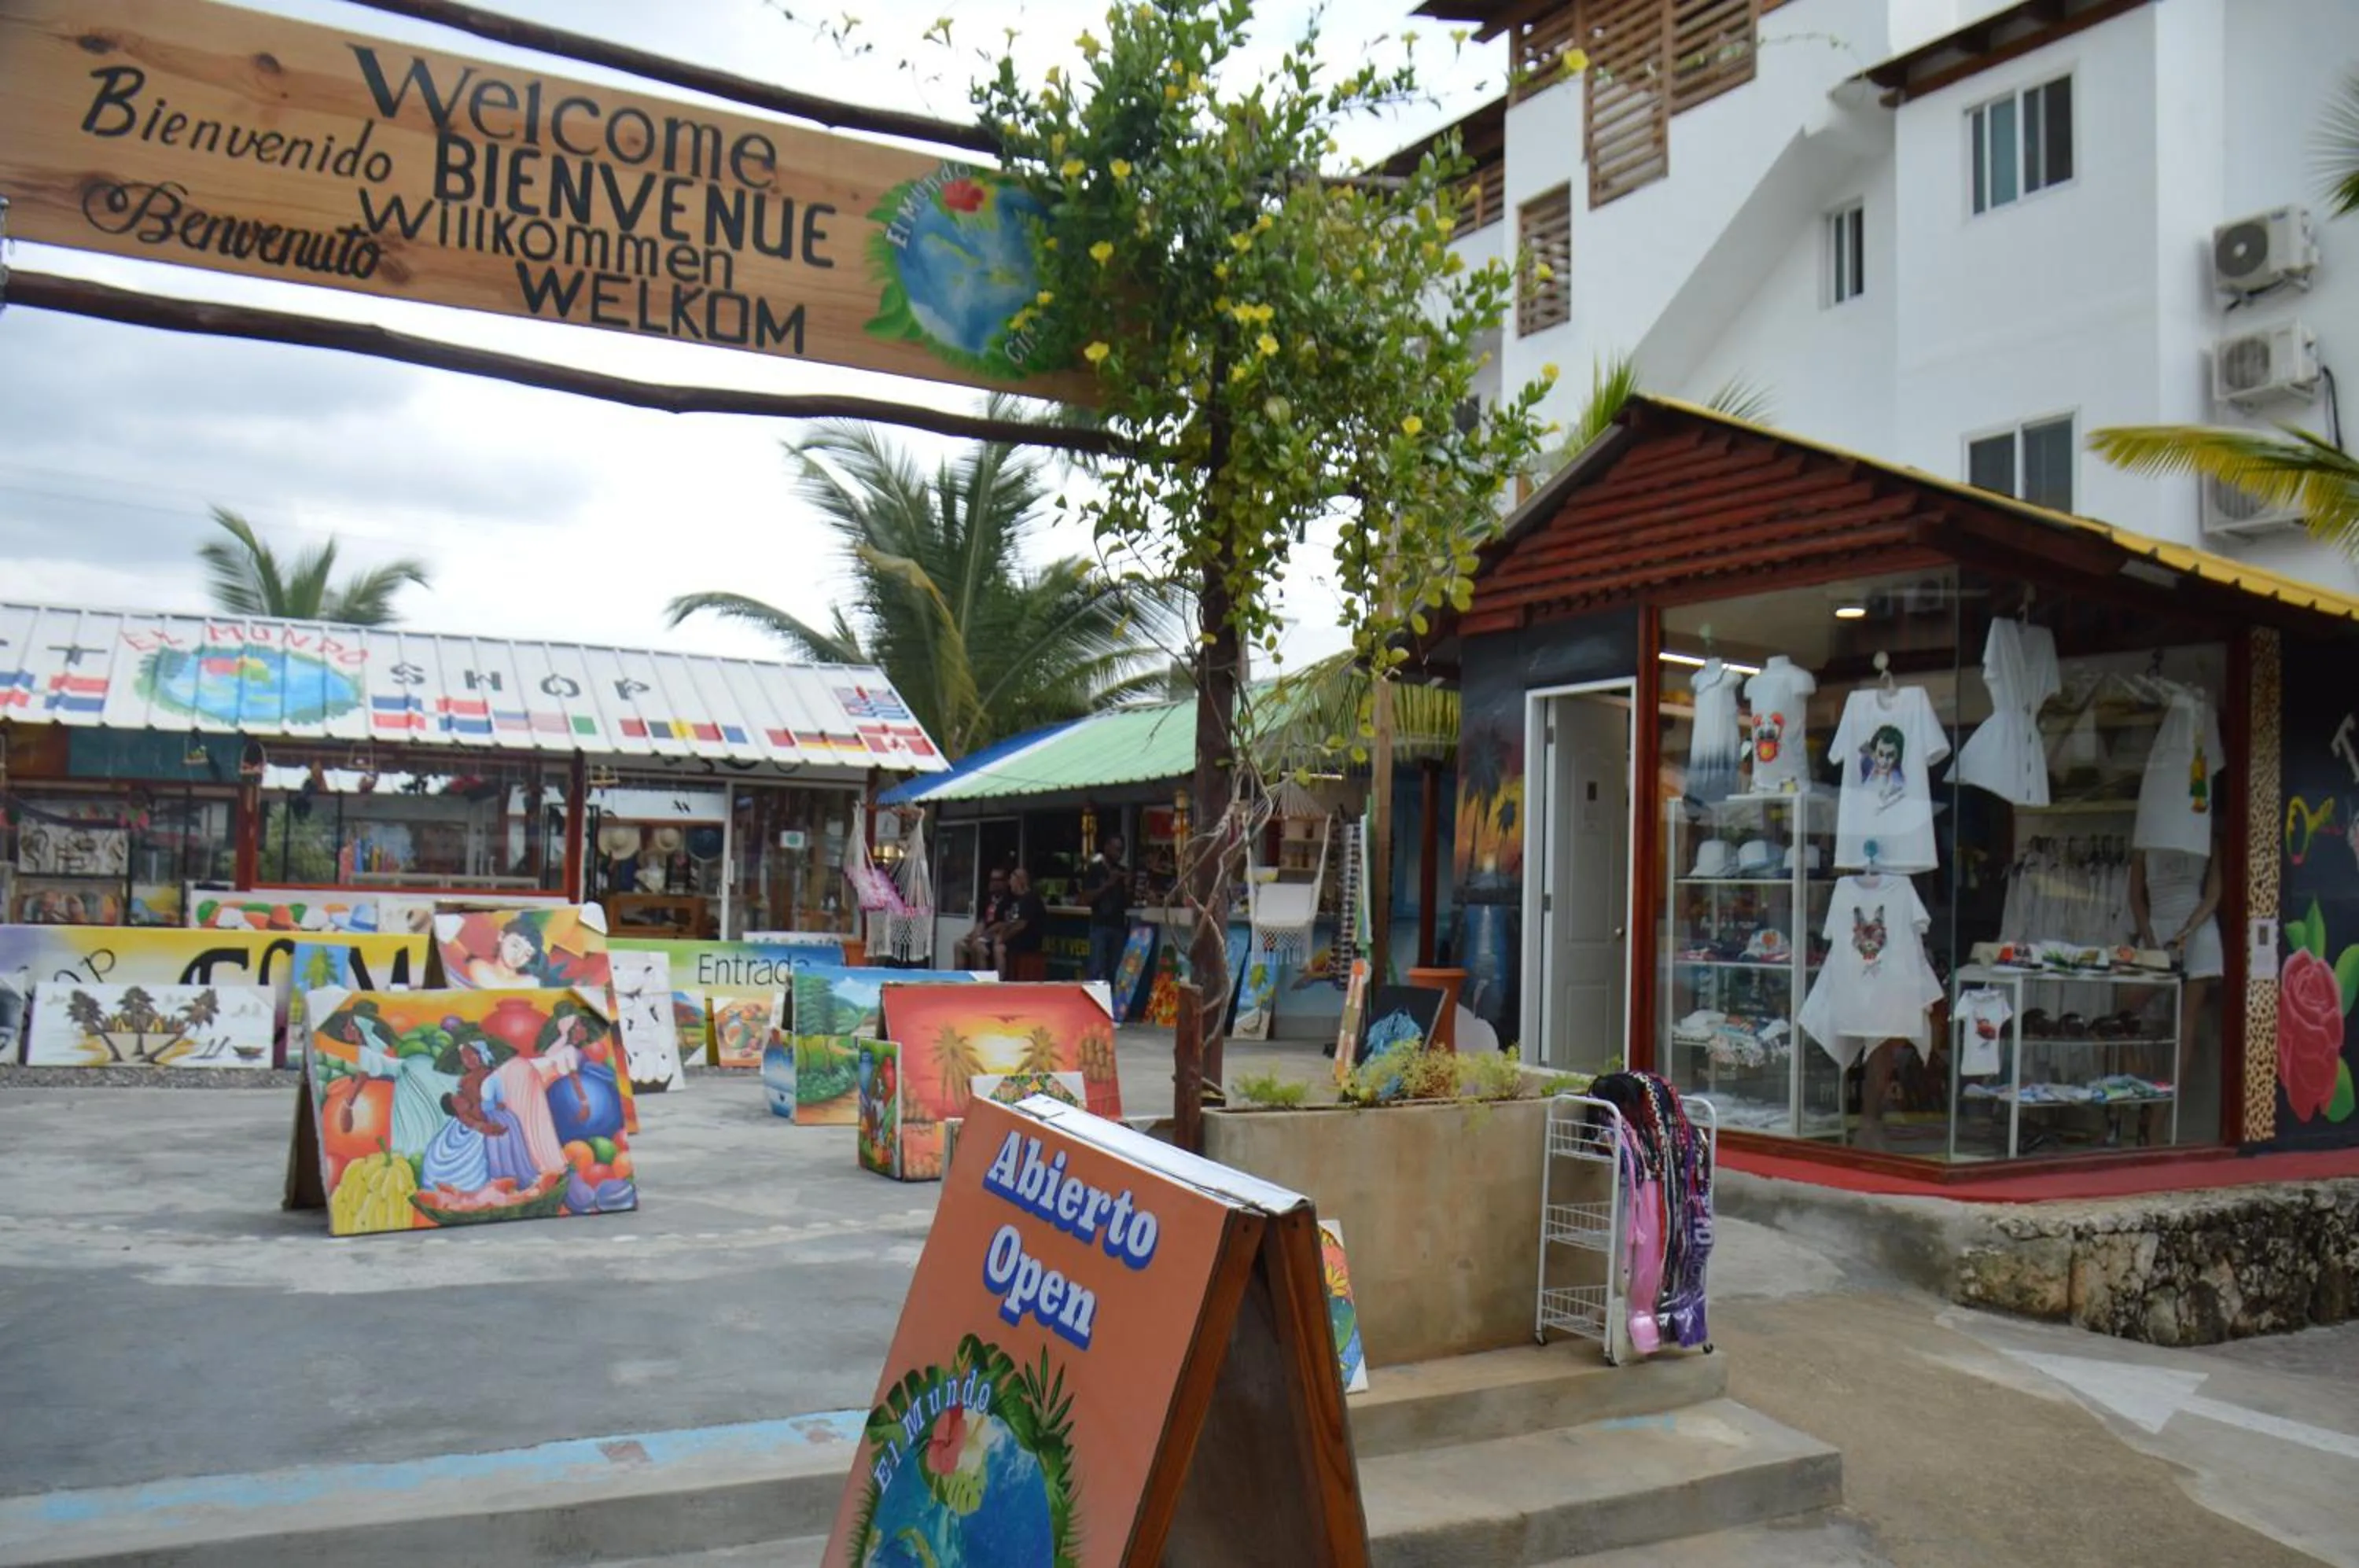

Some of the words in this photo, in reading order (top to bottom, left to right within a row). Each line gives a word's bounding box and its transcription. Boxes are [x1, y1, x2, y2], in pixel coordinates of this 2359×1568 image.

[81, 65, 392, 183] Bienvenido
[346, 42, 777, 190] Welcome
[83, 180, 387, 280] Benvenuto
[434, 131, 837, 269] BIENVENUE
[515, 259, 806, 355] WELKOM
[390, 662, 651, 701] SHOP
[697, 952, 811, 986] Entrad
[983, 1129, 1158, 1269] Abierto
[983, 1224, 1096, 1350] Open
[874, 1441, 900, 1494] El
[902, 1368, 992, 1445] Mundo
